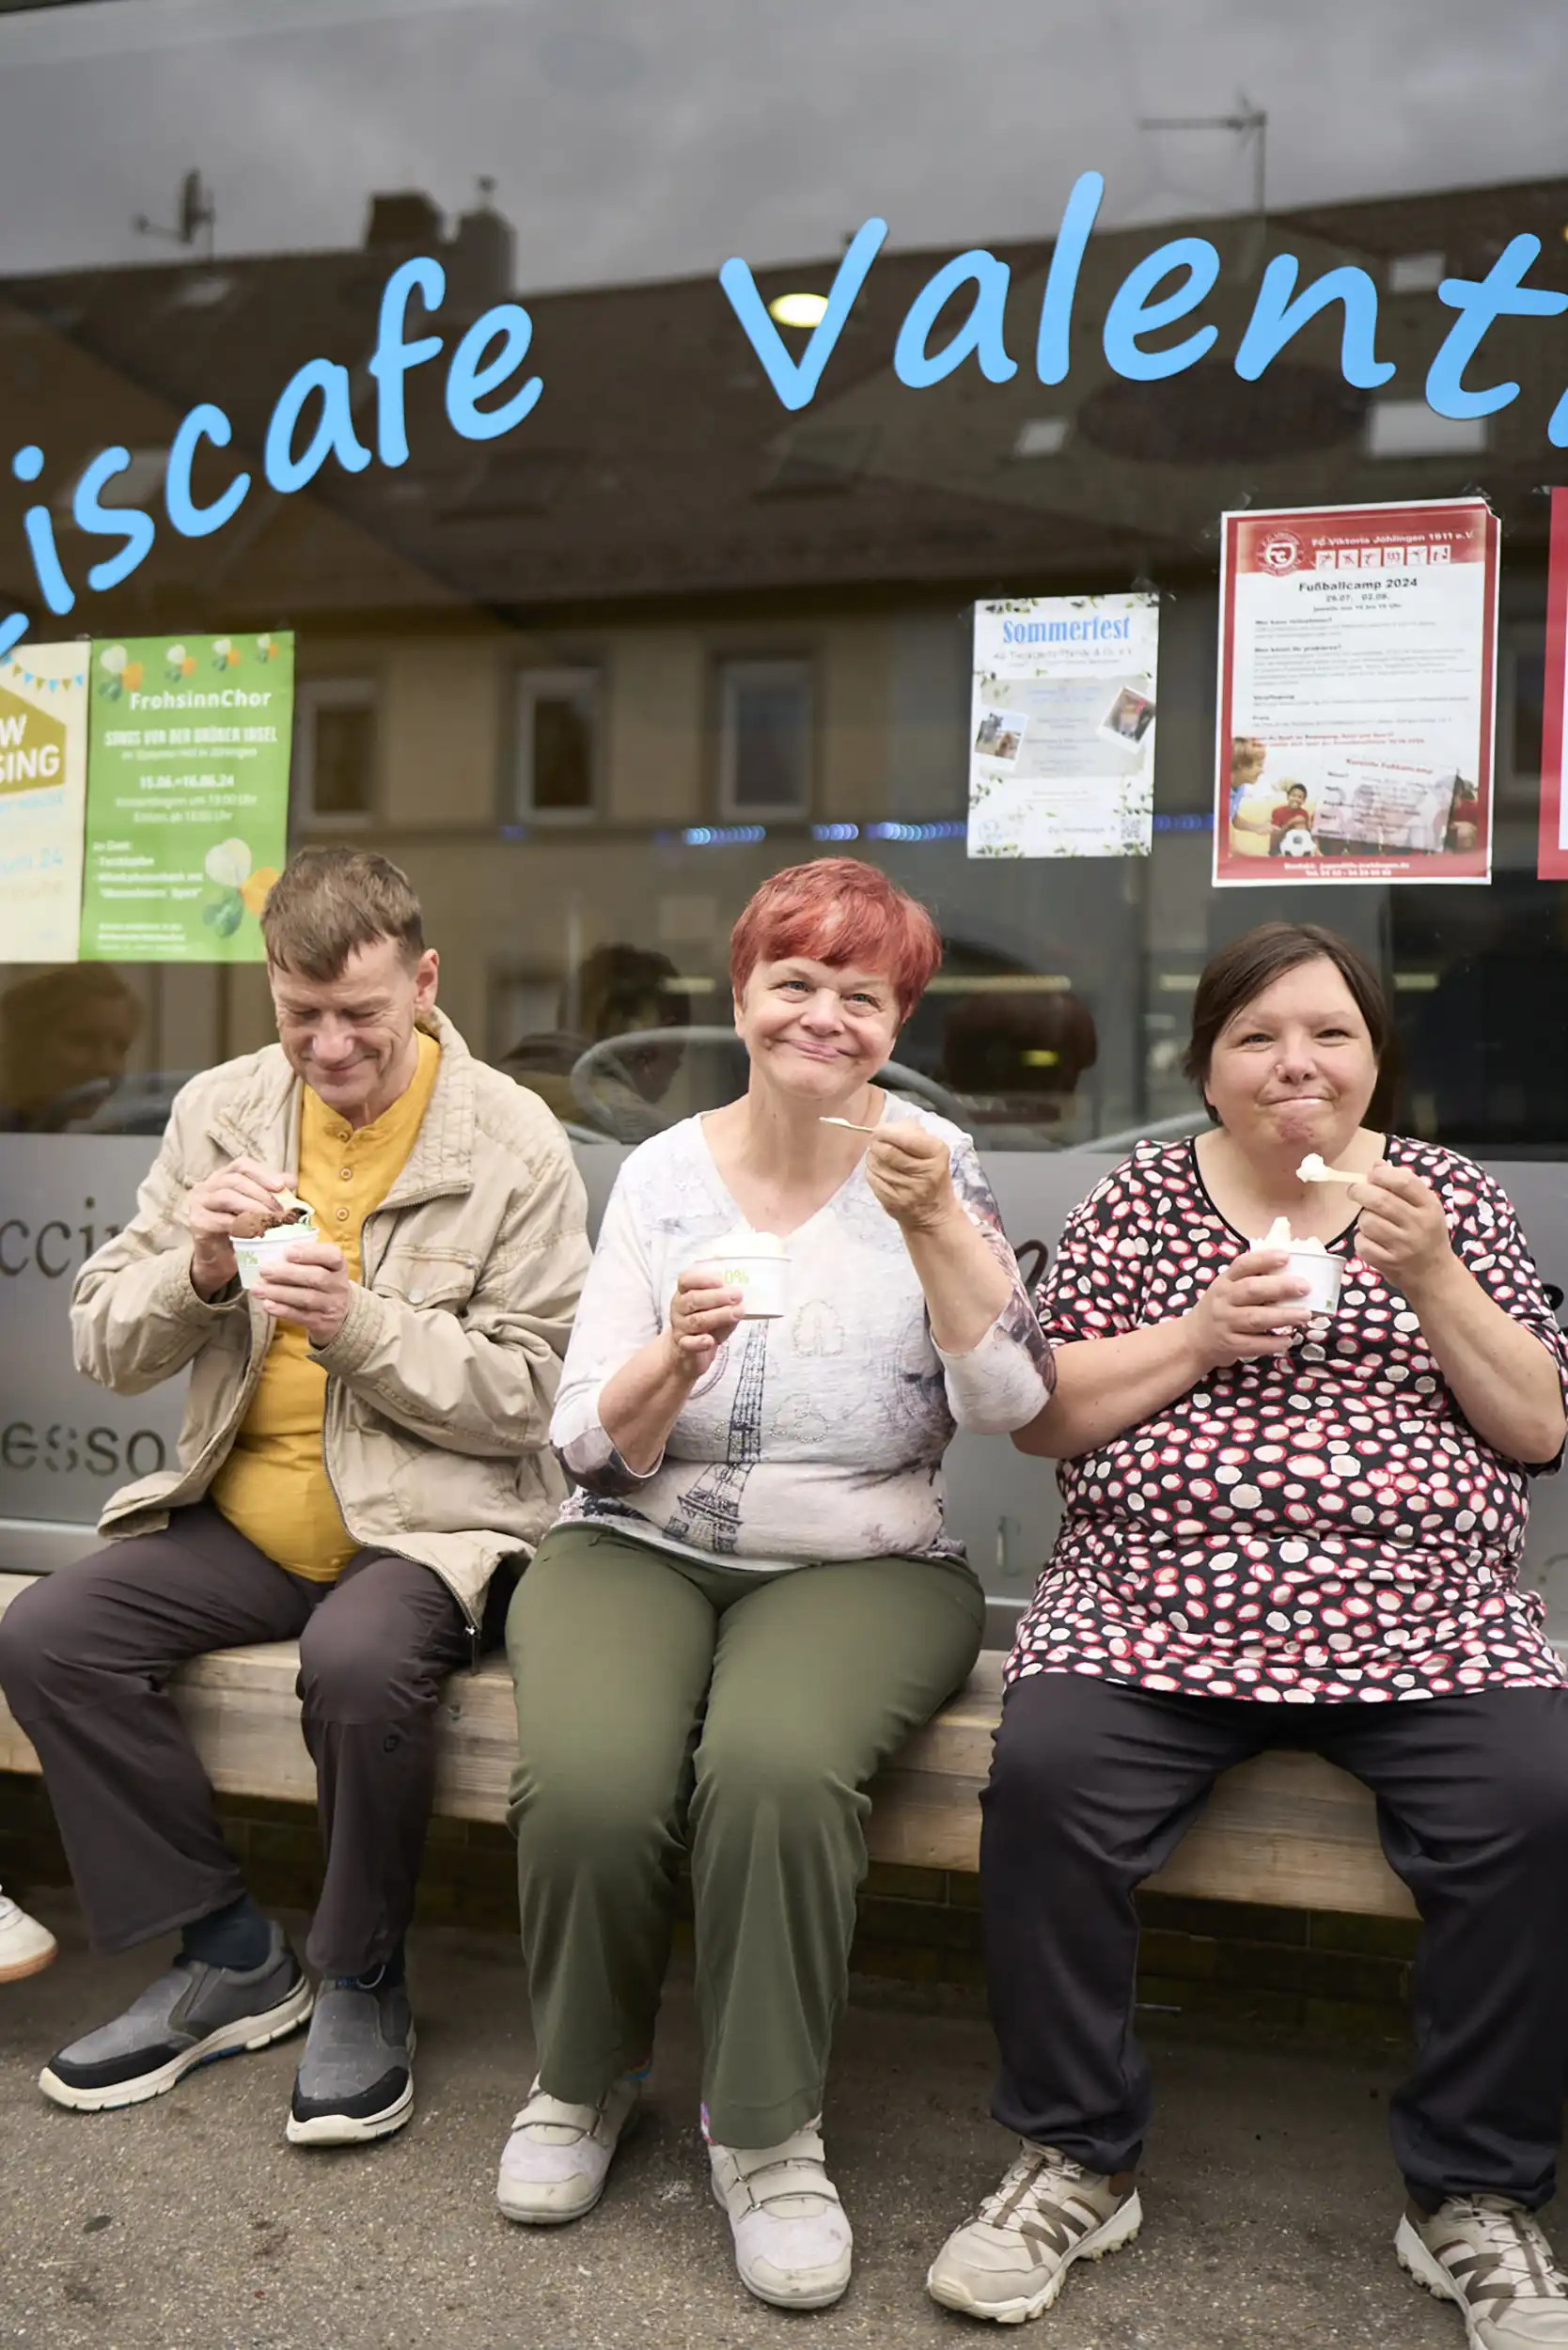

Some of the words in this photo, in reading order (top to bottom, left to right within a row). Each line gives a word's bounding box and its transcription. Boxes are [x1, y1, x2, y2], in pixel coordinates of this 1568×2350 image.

[1299, 580, 1382, 593] Fußballcamp
[1387, 577, 1419, 589] 2024
[1003, 616, 1131, 644] Sommerfest
[129, 688, 272, 711] FrohsinnChor
